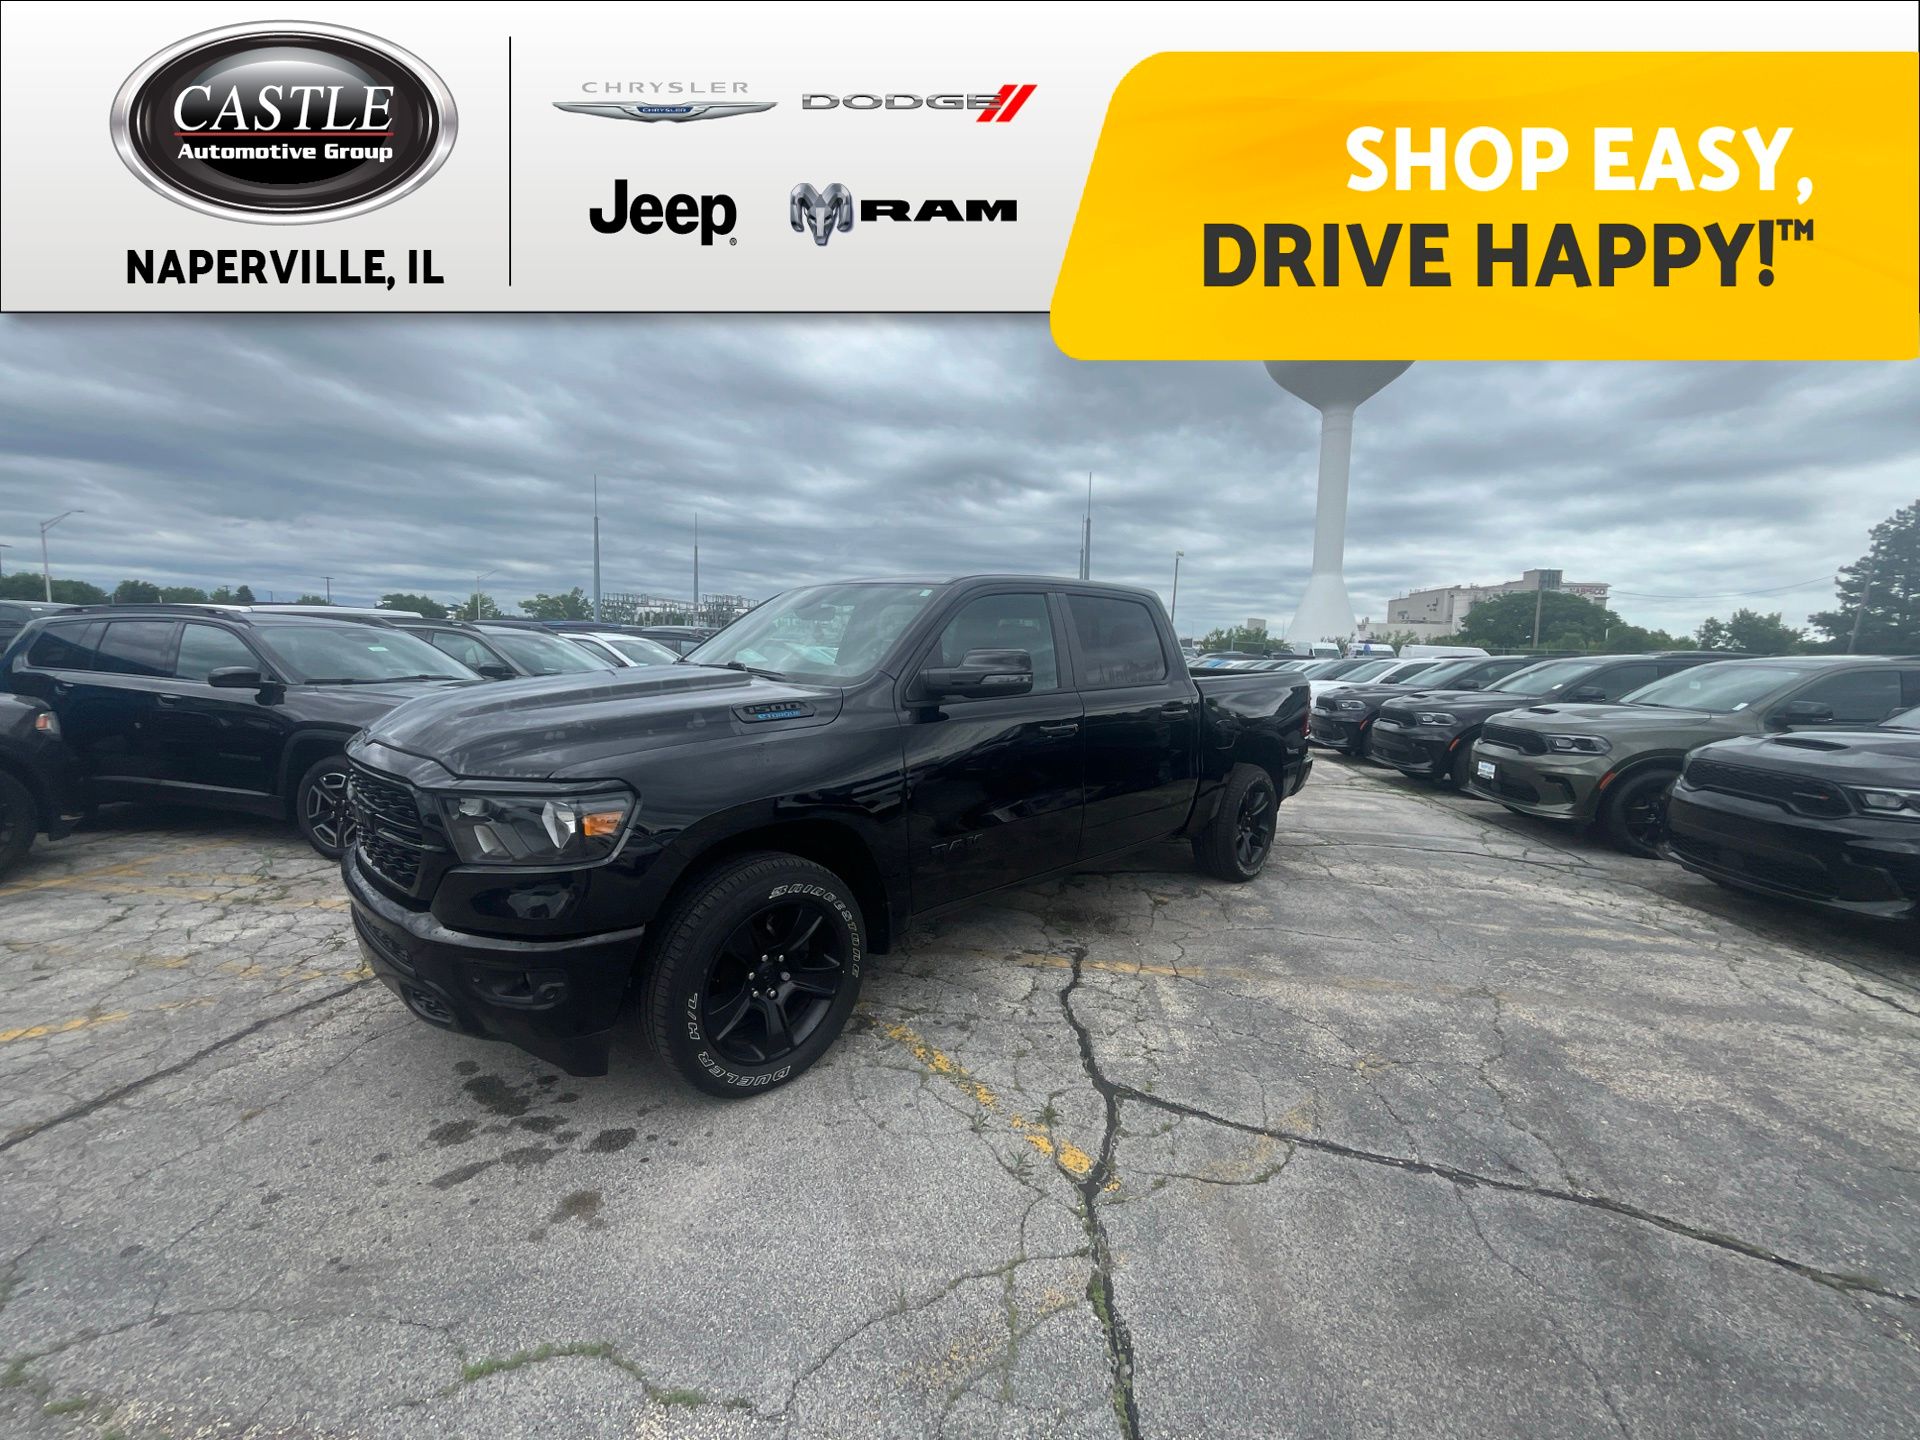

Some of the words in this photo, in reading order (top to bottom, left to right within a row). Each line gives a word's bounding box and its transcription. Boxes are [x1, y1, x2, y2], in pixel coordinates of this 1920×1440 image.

[745, 702, 801, 714] 1500
[769, 883, 861, 978] BRIDGESTONE
[685, 992, 701, 1041] H/L
[697, 1050, 791, 1088] DUELER
